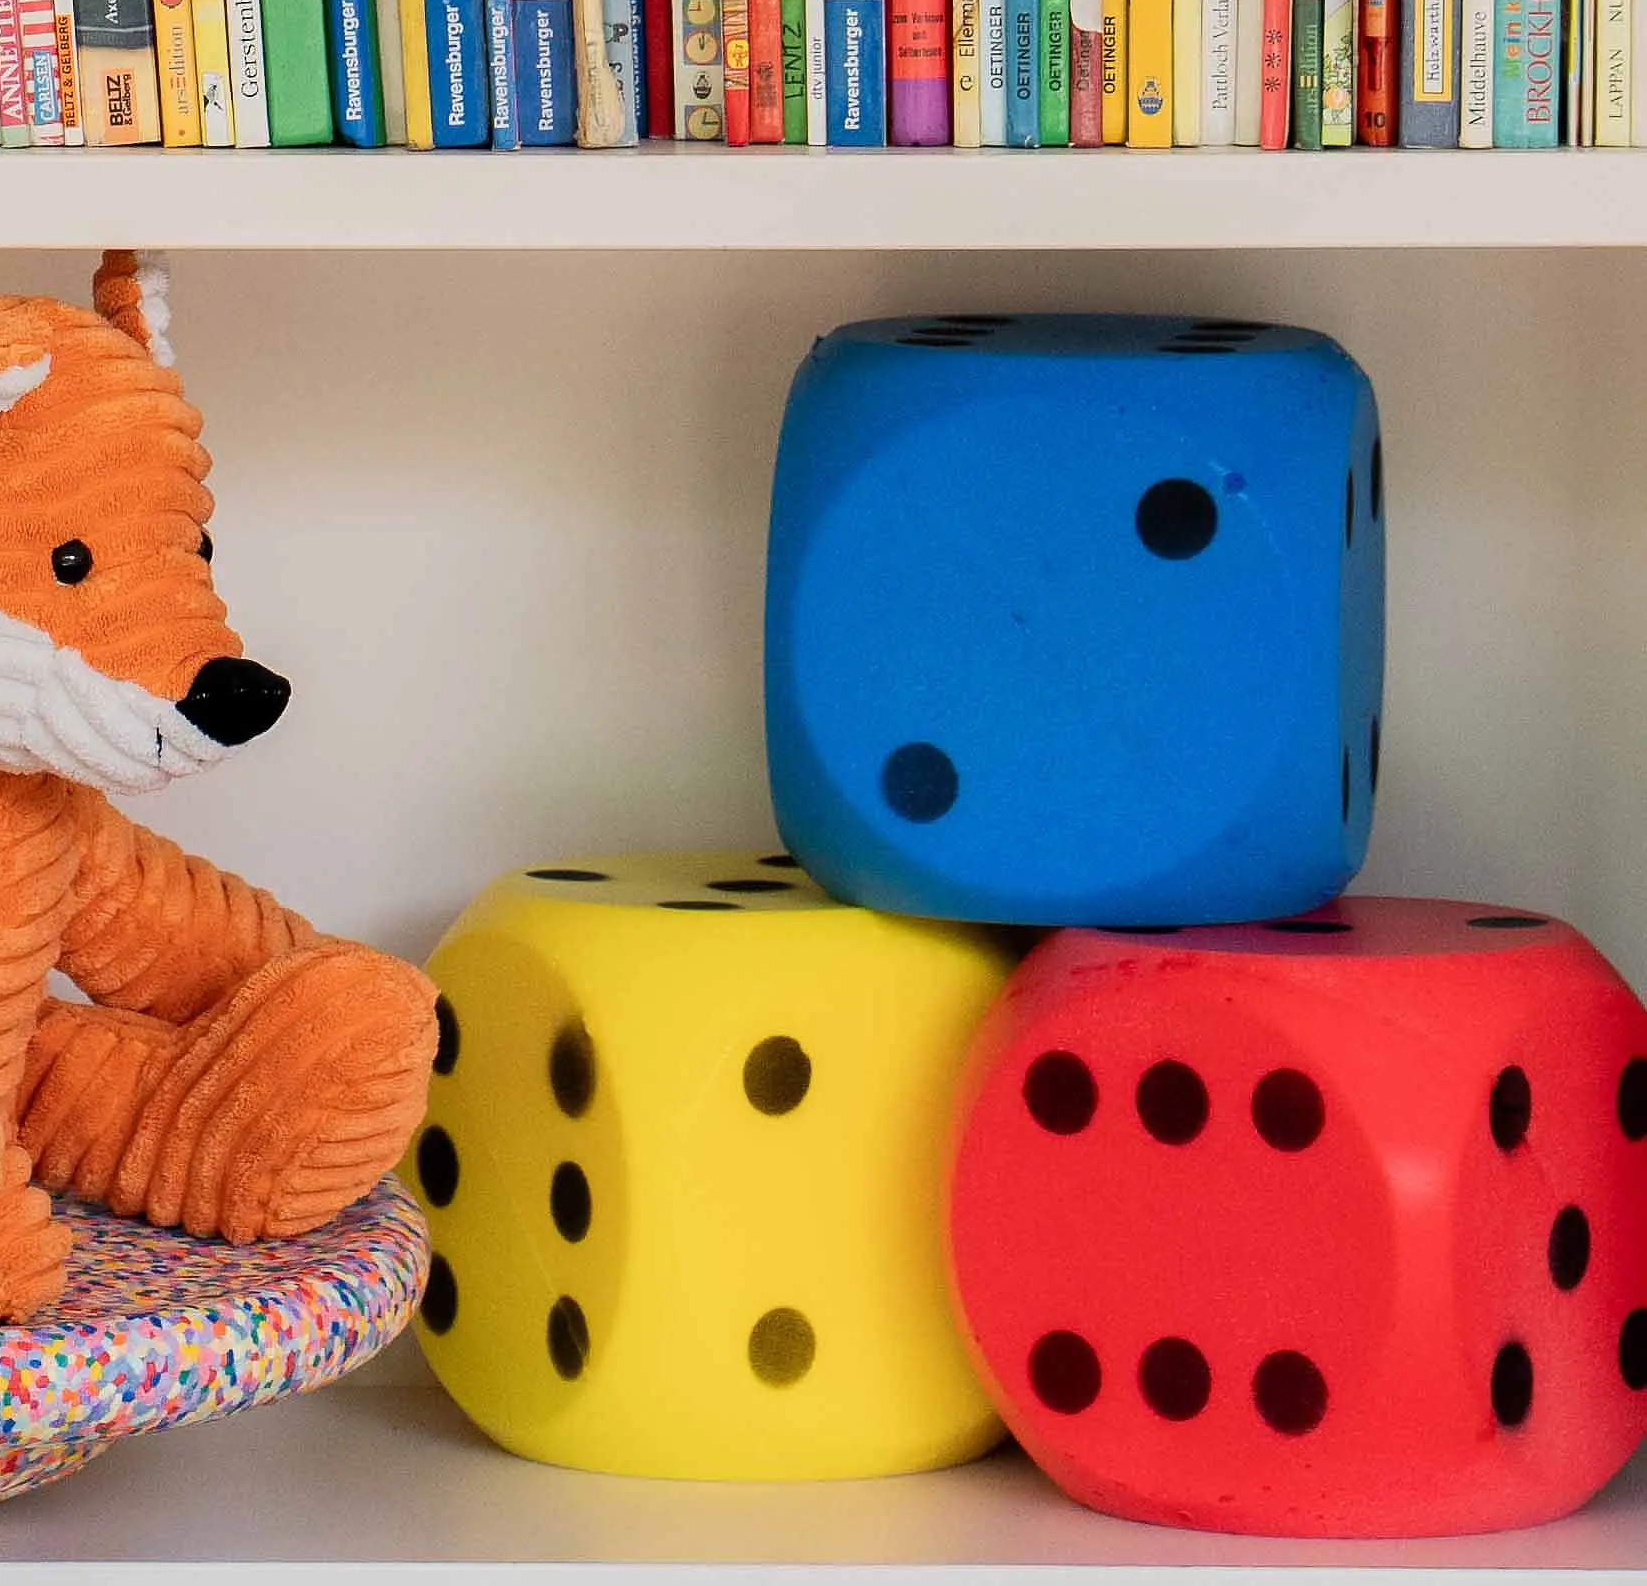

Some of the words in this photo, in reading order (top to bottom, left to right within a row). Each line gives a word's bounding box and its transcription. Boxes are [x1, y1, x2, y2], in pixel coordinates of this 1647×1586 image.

[33, 52, 53, 122] CARLSEN
[534, 9, 558, 131] Ravensburger
[781, 21, 806, 100] LENTZ
[842, 8, 865, 130] Ravensburger
[987, 5, 1006, 89] OETINGER
[1015, 12, 1033, 100] OETINGER
[1046, 10, 1065, 92] OETINGER
[1101, 15, 1118, 94] OETINGER
[1468, 11, 1489, 126] Middelhauve
[105, 75, 125, 126] BELTZ
